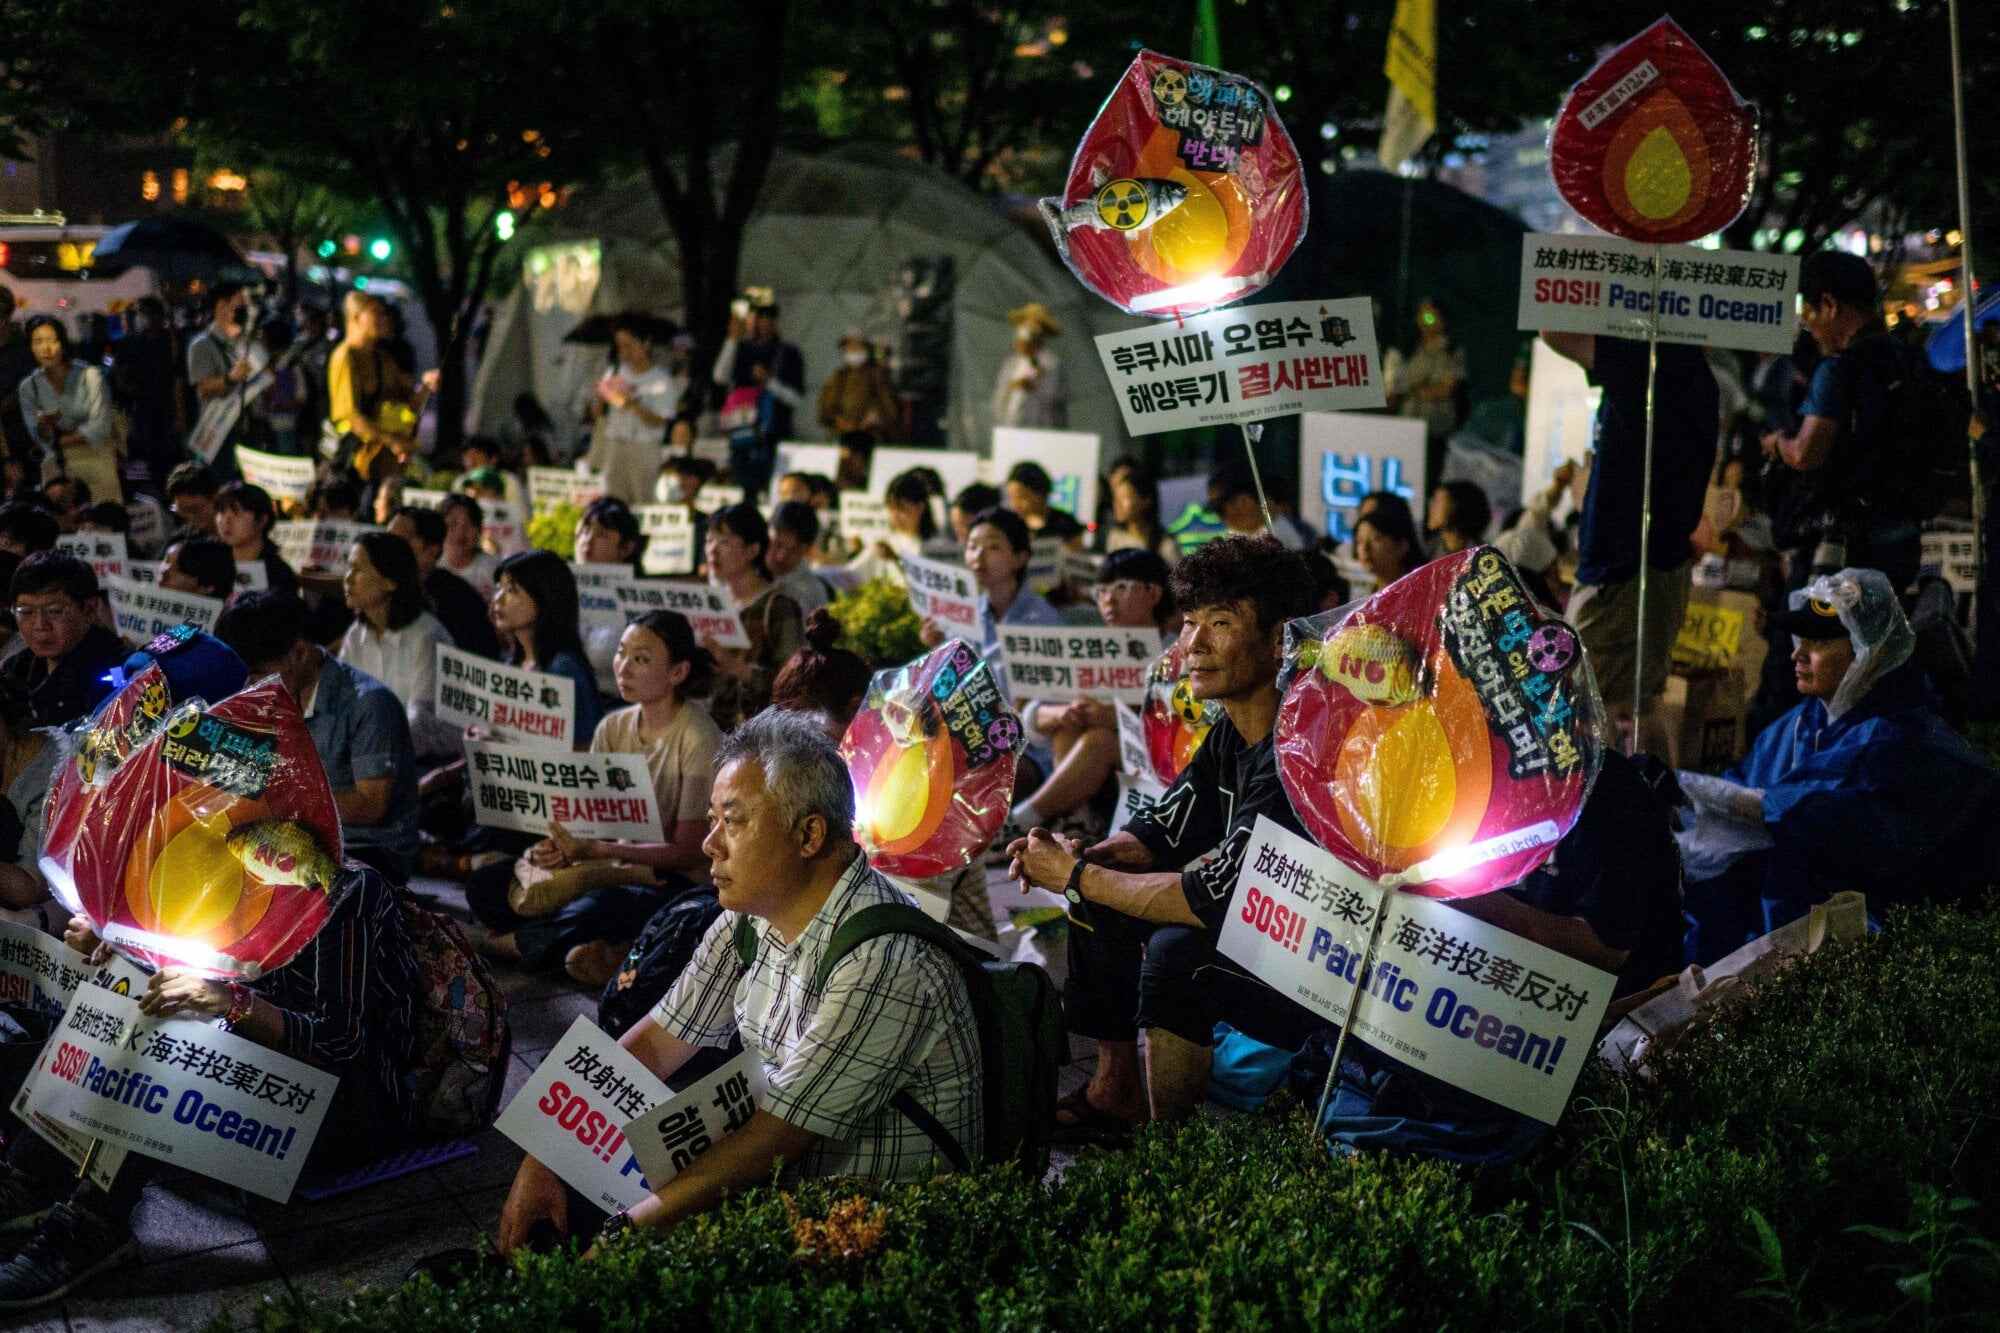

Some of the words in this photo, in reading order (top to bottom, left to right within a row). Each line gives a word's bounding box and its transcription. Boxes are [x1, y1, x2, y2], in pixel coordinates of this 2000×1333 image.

[1165, 108, 1257, 141] 해양투기
[1535, 247, 1655, 278] 放射性汚染水
[1662, 258, 1788, 292] 海洋投棄反対
[1535, 277, 1600, 306] SOS!!
[1608, 283, 1690, 316] Pacfic
[1699, 294, 1783, 325] Ocean!
[1111, 330, 1214, 375] 후쿠시마
[1223, 316, 1313, 357] 오염수
[1126, 371, 1231, 414] 해양투기
[1238, 354, 1369, 400] 결사반대!
[1005, 635, 1063, 659] 후쿠시마
[1068, 638, 1121, 660] 오염수
[1339, 652, 1386, 684] NO
[441, 655, 487, 691] 후쿠시마
[491, 674, 534, 703] 오염수
[1011, 662, 1072, 689] 해양투기
[1076, 665, 1145, 689] 결사반
[440, 683, 489, 722] 해양투기
[492, 701, 566, 741] 결사반대!
[474, 750, 538, 784] 후쿠시마
[541, 761, 601, 790] 오염수
[480, 783, 548, 818] 해양투기
[551, 795, 649, 824] 결사반대!
[254, 842, 297, 873] NO
[0, 936, 58, 982] 射性汚染水
[1254, 842, 1383, 935] 放射性汚染水
[1391, 914, 1590, 1023] 海洋投棄反対
[1241, 887, 1308, 954] SOS!!
[1425, 986, 1568, 1076] Ocean!
[141, 1030, 316, 1116] 海洋投棄反対
[565, 1045, 655, 1121] 放射性
[51, 1041, 91, 1089] SOS!!
[84, 1055, 169, 1116] Pacific
[173, 1089, 297, 1161] Ocean!
[538, 1080, 627, 1165] SOS!!
[712, 1070, 757, 1135] 후쿠
[658, 1103, 713, 1175] 해양
